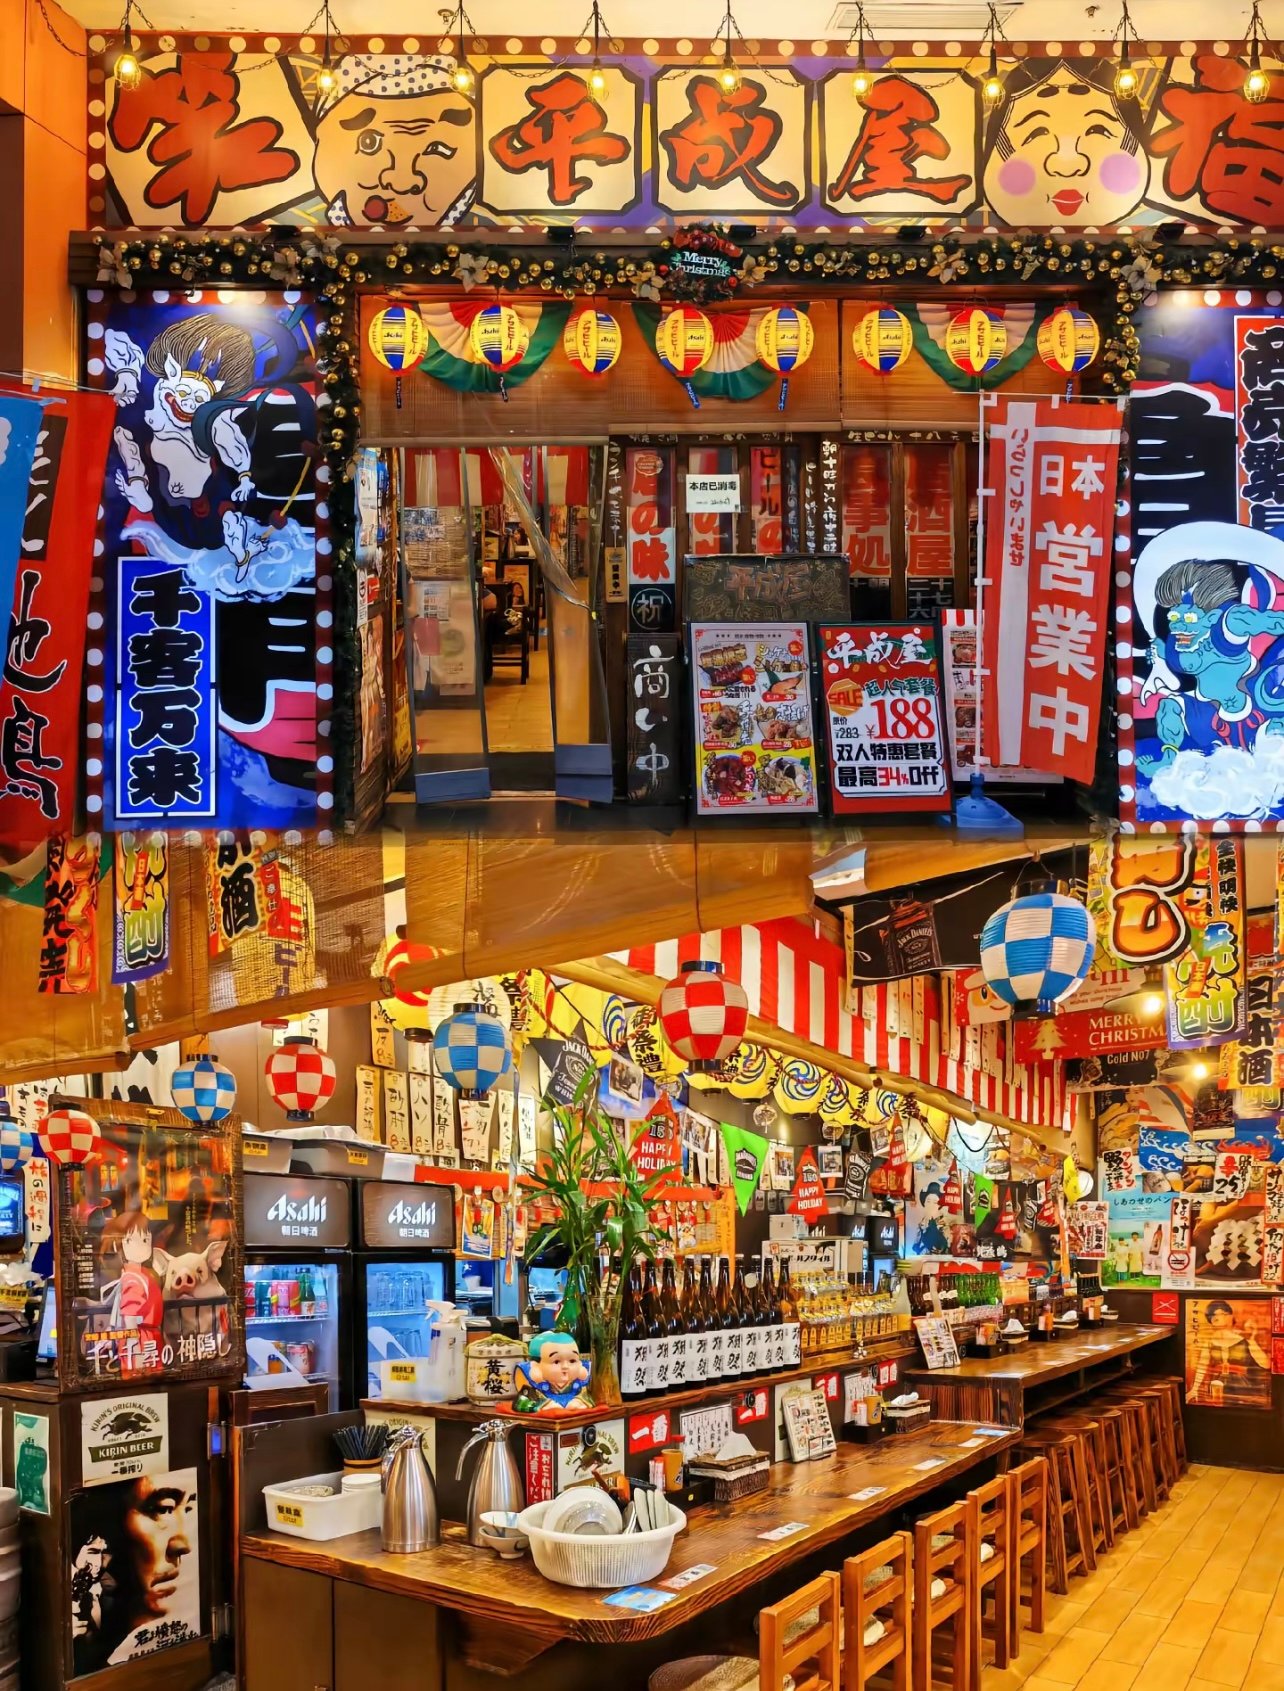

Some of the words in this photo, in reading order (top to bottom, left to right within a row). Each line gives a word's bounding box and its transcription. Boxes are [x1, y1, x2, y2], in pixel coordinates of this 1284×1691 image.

[683, 251, 722, 267] Merry
[689, 481, 737, 491] 本店已消毒
[1040, 455, 1105, 500] 日本
[636, 592, 665, 624] 祝
[1028, 520, 1104, 757] 営業中
[128, 566, 204, 807] 千客万来
[865, 679, 938, 698] 超人气套餐
[828, 690, 864, 708] SALE
[634, 645, 674, 790] 商い中
[836, 743, 938, 761] 双人特惠套餐
[1089, 1024, 1167, 1045] CHRISTM
[798, 1186, 819, 1198] HAPPY
[1113, 1196, 1172, 1207] しあわせのパン
[267, 1194, 327, 1223] Asahi
[387, 1200, 437, 1224] Asahi
[797, 1198, 823, 1210] HOLIDAY
[281, 1225, 318, 1237] 朝日啤酒
[85, 1332, 232, 1374] 千と千尋の神隠し
[91, 1408, 112, 1432] KIRIN'S
[113, 1402, 144, 1412] ORIGINAL
[631, 1414, 668, 1443] 一番
[98, 1446, 127, 1459] KIRIN
[130, 1442, 154, 1454] BEER
[529, 1436, 539, 1502] ご注意くだ
